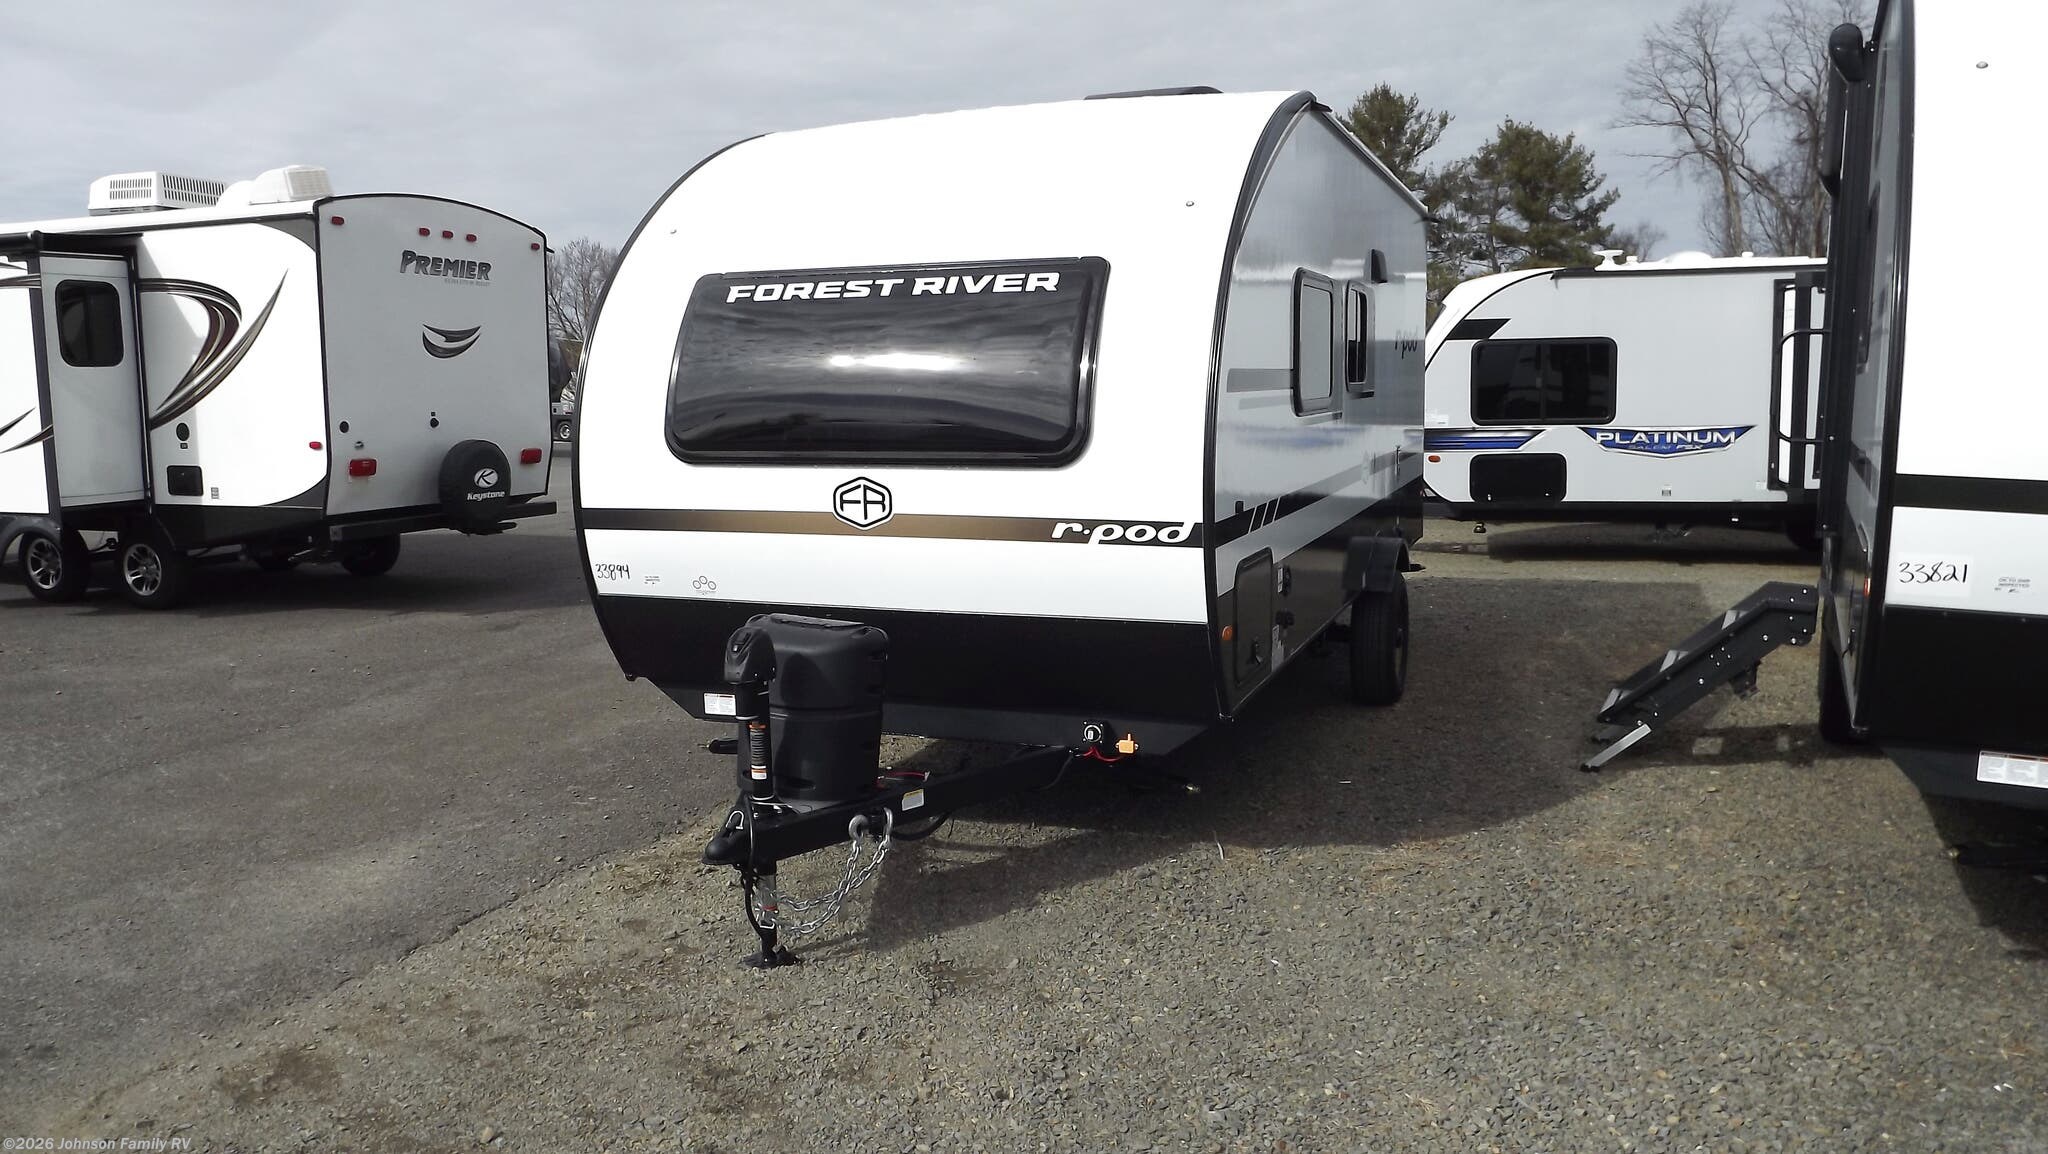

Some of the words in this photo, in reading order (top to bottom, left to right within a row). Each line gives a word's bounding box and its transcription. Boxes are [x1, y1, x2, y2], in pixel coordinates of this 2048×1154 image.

[400, 249, 492, 281] PREMIER
[726, 278, 905, 303] FOREST
[911, 272, 1061, 296] RIVER
[1596, 431, 1736, 444] PLATINUM
[467, 491, 506, 502] Keystone
[595, 563, 630, 581] 33894
[1899, 561, 1968, 583] 33821
